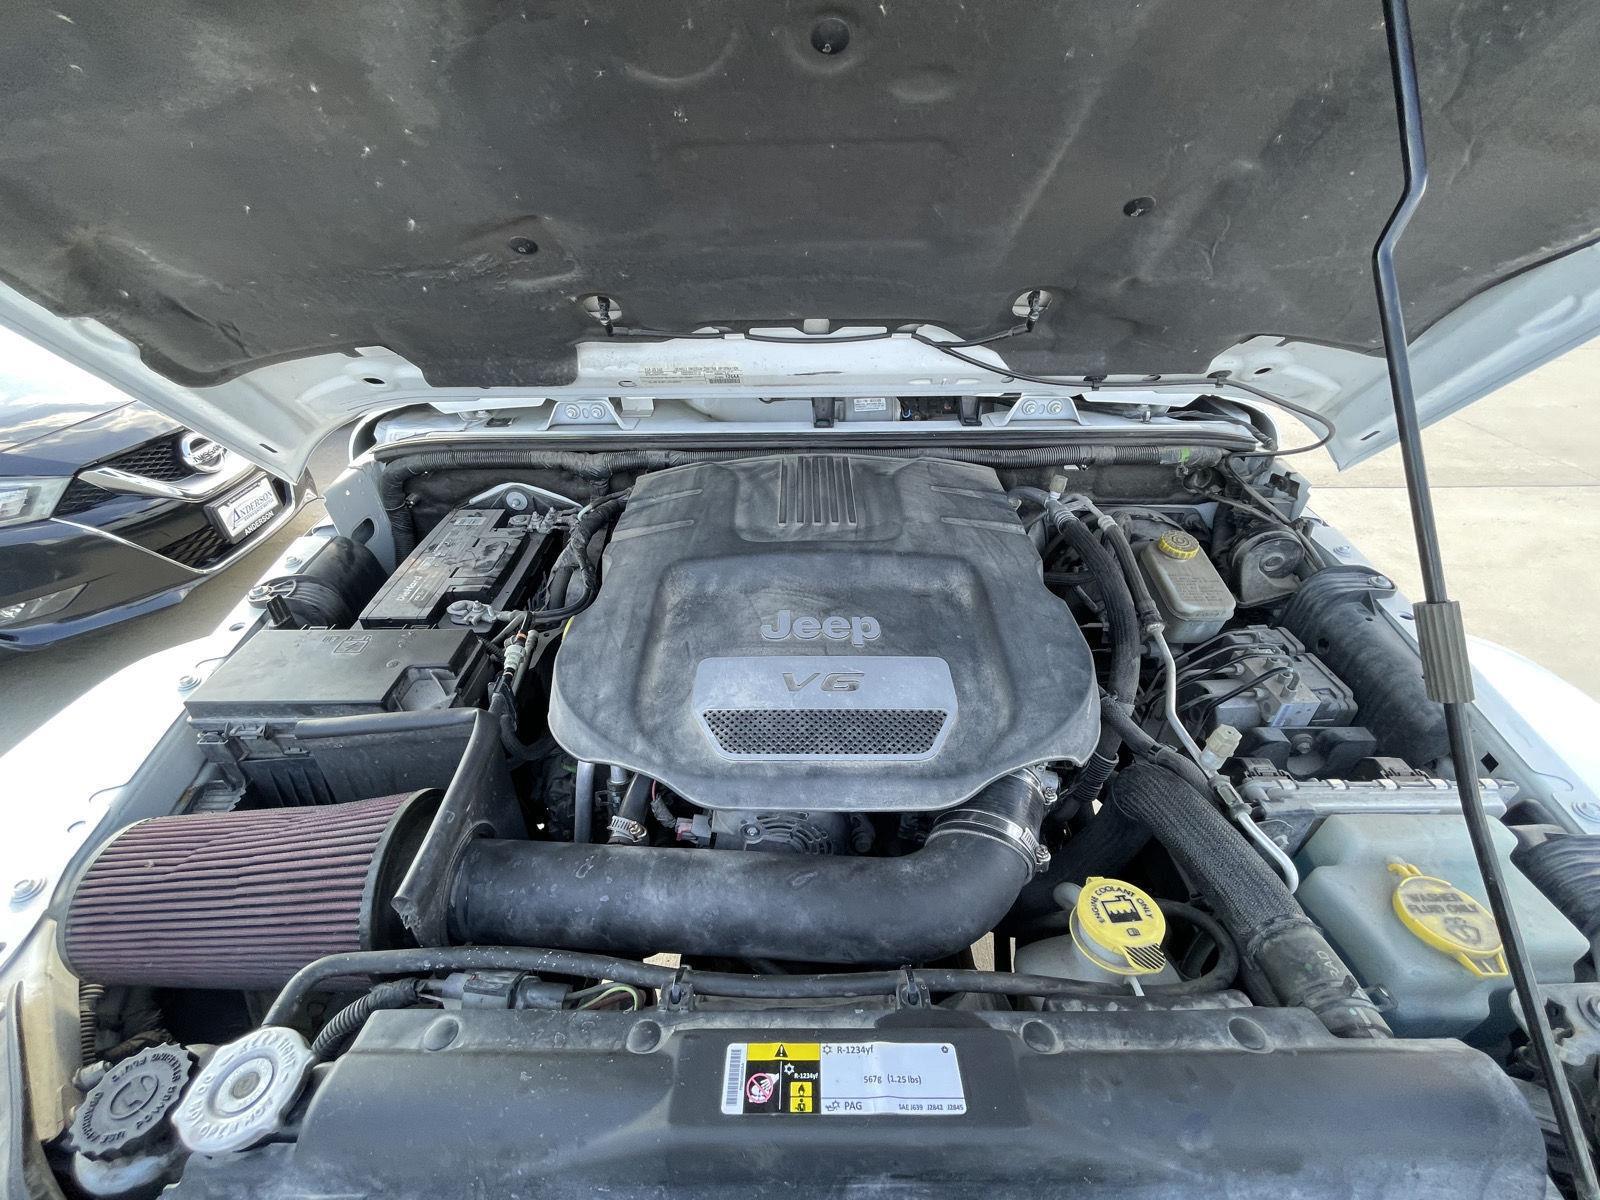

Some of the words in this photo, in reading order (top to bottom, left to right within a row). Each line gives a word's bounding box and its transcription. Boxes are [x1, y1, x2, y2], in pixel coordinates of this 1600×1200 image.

[244, 510, 275, 536] ANDERSON
[760, 609, 882, 647] Jeep
[782, 672, 865, 692] V6
[1095, 885, 1135, 897] COOLANT
[1090, 896, 1106, 924] ENGINE
[1137, 897, 1154, 920] ONLY
[836, 1045, 874, 1055] R-1234yf
[793, 1072, 819, 1080] R-1234yf
[863, 1075, 883, 1085] 567g
[887, 1073, 907, 1084] (1.25
[907, 1074, 922, 1085] lbs)
[844, 1101, 863, 1111] PAG
[898, 1103, 910, 1111] SAE
